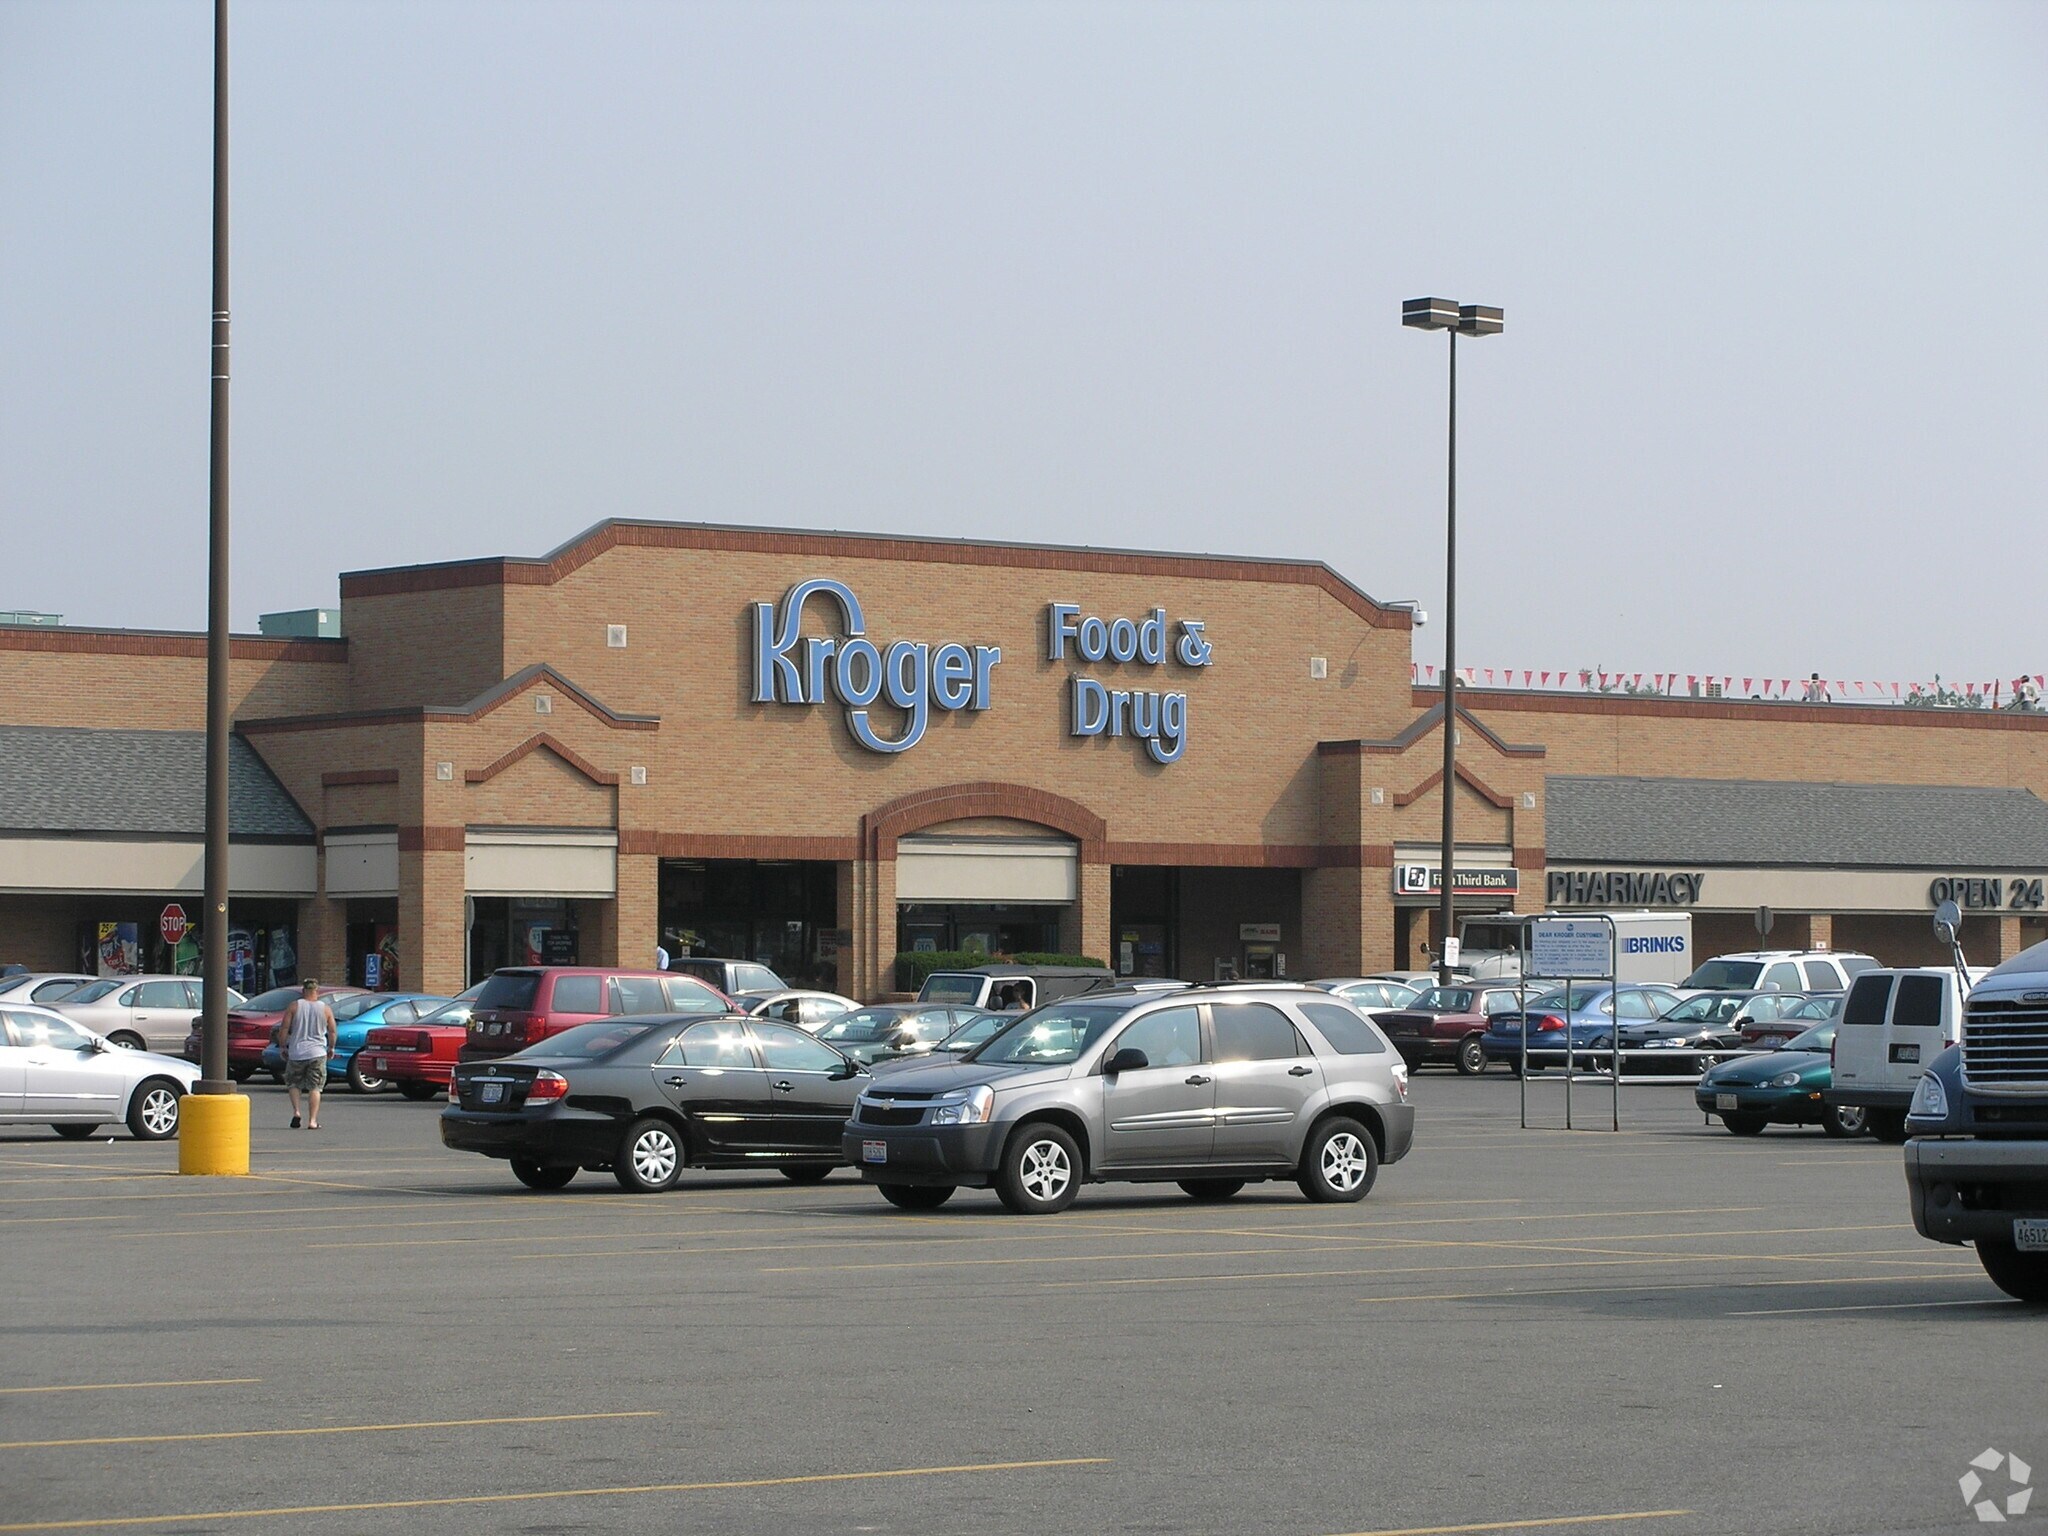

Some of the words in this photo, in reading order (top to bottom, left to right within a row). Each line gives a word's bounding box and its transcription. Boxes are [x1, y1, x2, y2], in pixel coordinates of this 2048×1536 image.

[1048, 602, 1166, 664] Food
[1176, 618, 1212, 666] &
[750, 578, 1001, 754] Kroger
[1070, 676, 1187, 764] Drug
[1456, 873, 1482, 886] Third
[1483, 873, 1507, 886] Bank
[1548, 871, 1705, 904] PHARMACY
[1930, 877, 2002, 907] OPEN
[2009, 878, 2045, 908] 24
[162, 917, 185, 931] STOP
[1629, 936, 1685, 953] BRINKS
